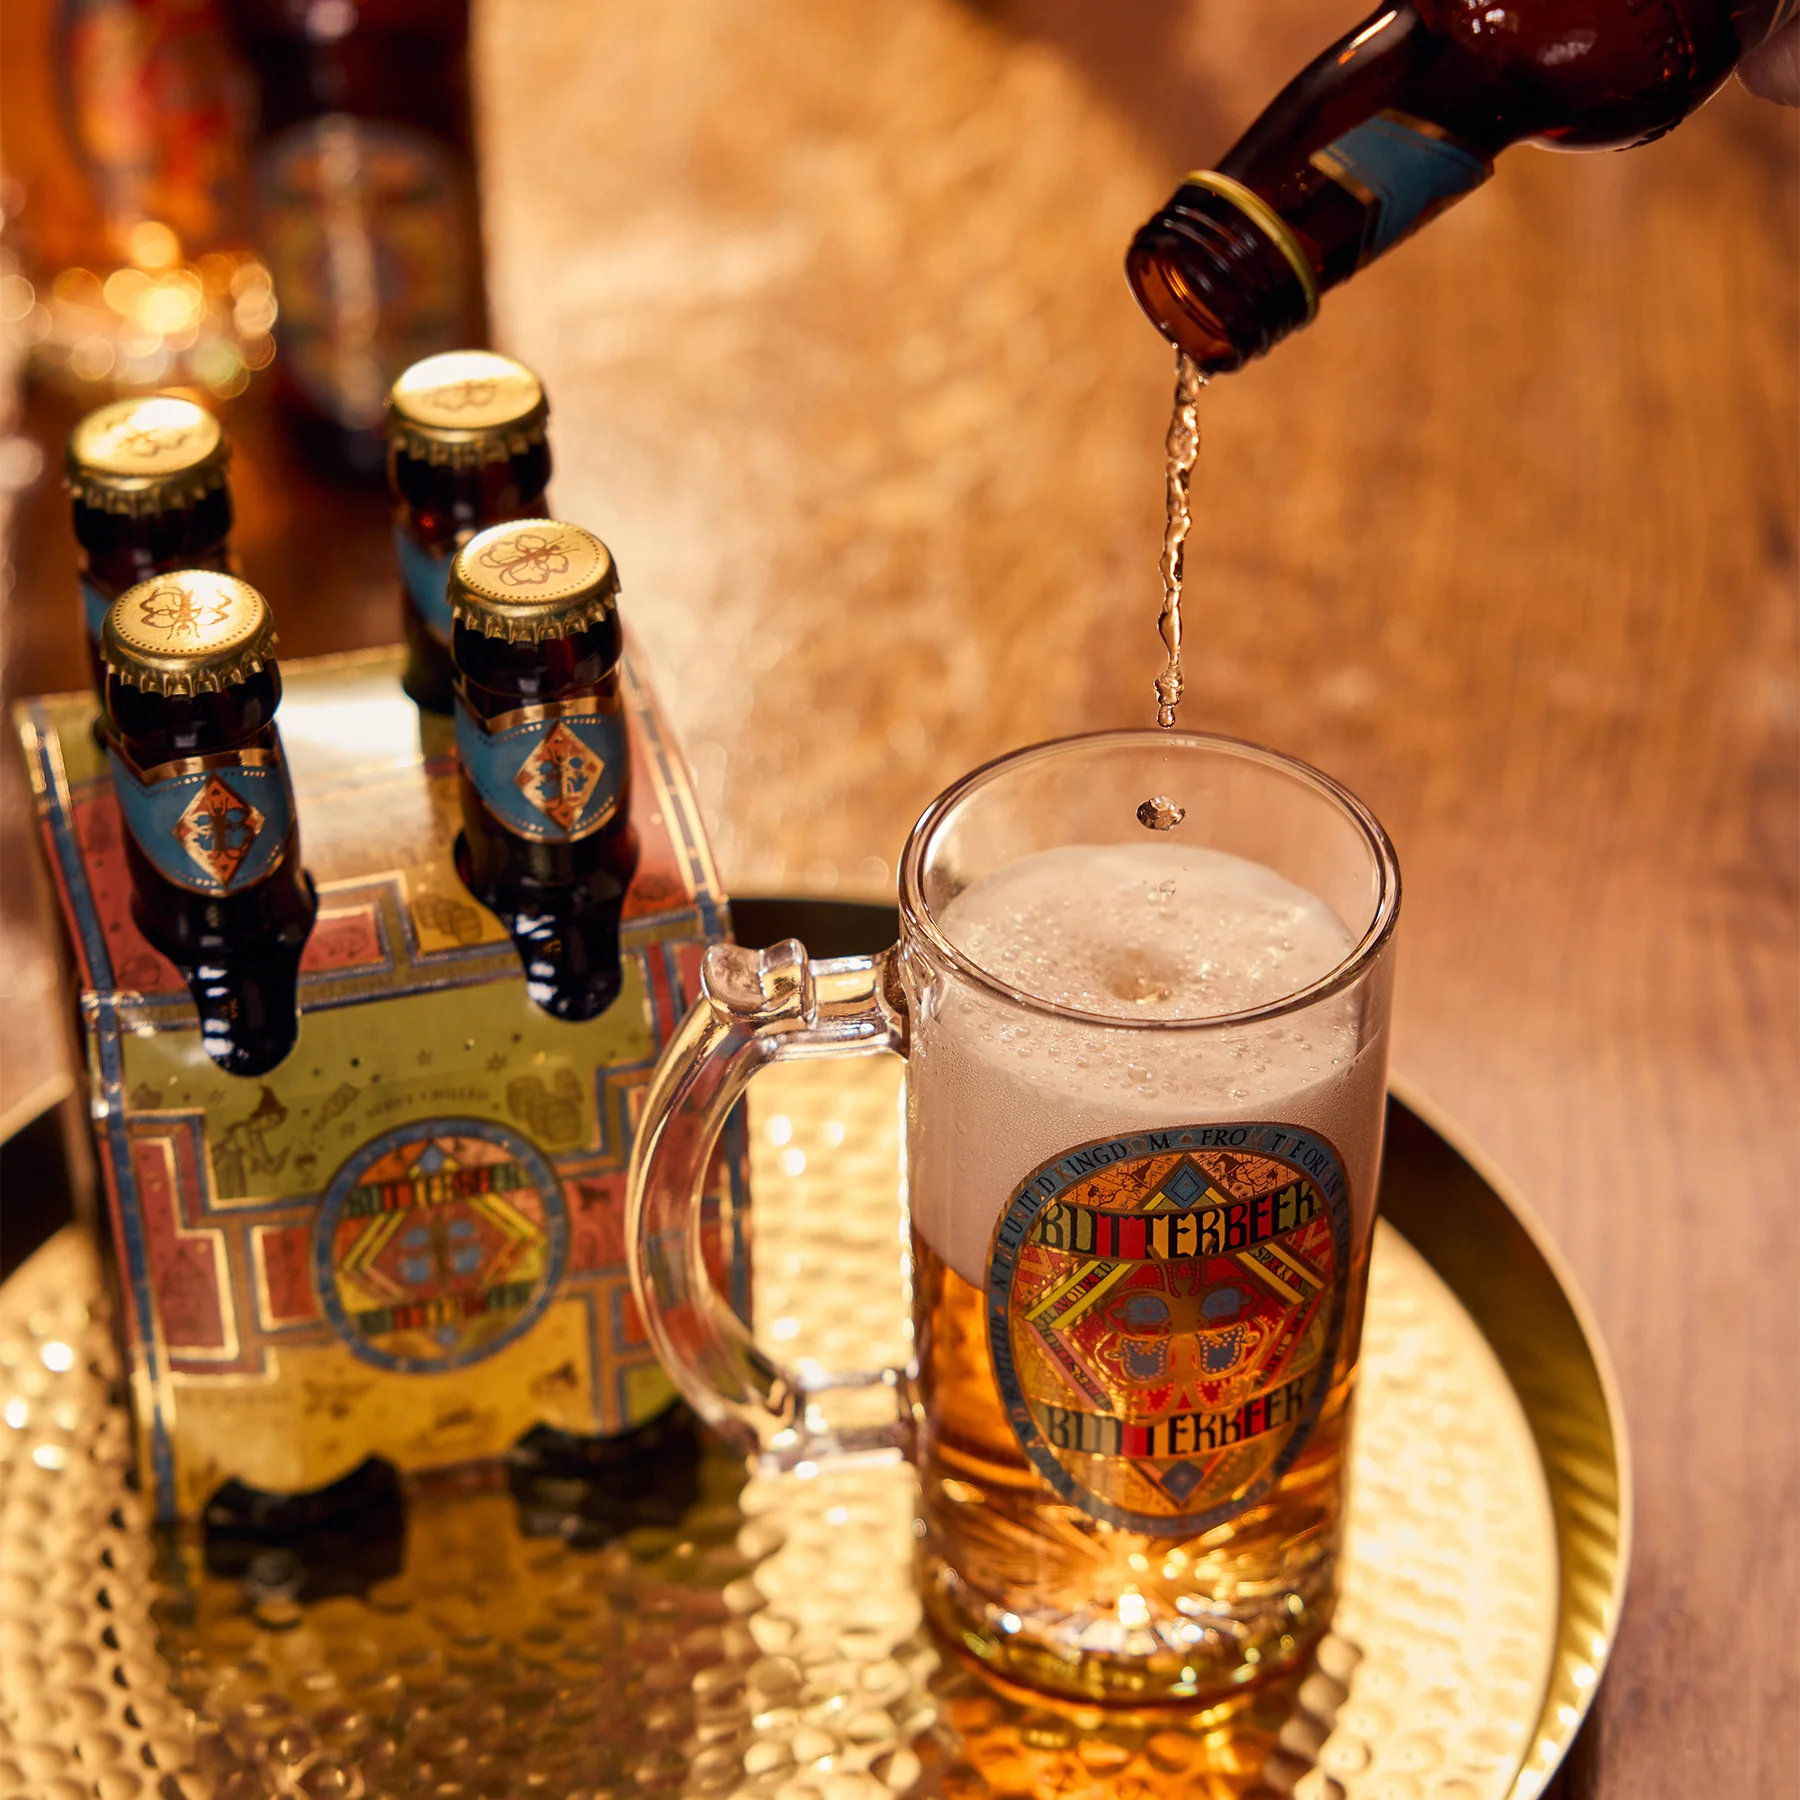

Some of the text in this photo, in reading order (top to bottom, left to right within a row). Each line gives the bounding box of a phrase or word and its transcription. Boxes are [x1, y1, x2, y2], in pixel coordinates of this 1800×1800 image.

[1200, 1127, 1268, 1149] FROM
[1270, 1132, 1305, 1159] THE
[1004, 1175, 1056, 1234] UNITED
[1053, 1133, 1171, 1184] KINGDOM
[1038, 1180, 1315, 1257] BUTTERBEER
[1042, 1262, 1112, 1325] FLAVOURED
[1046, 1377, 1304, 1456] BUTTERBEER
